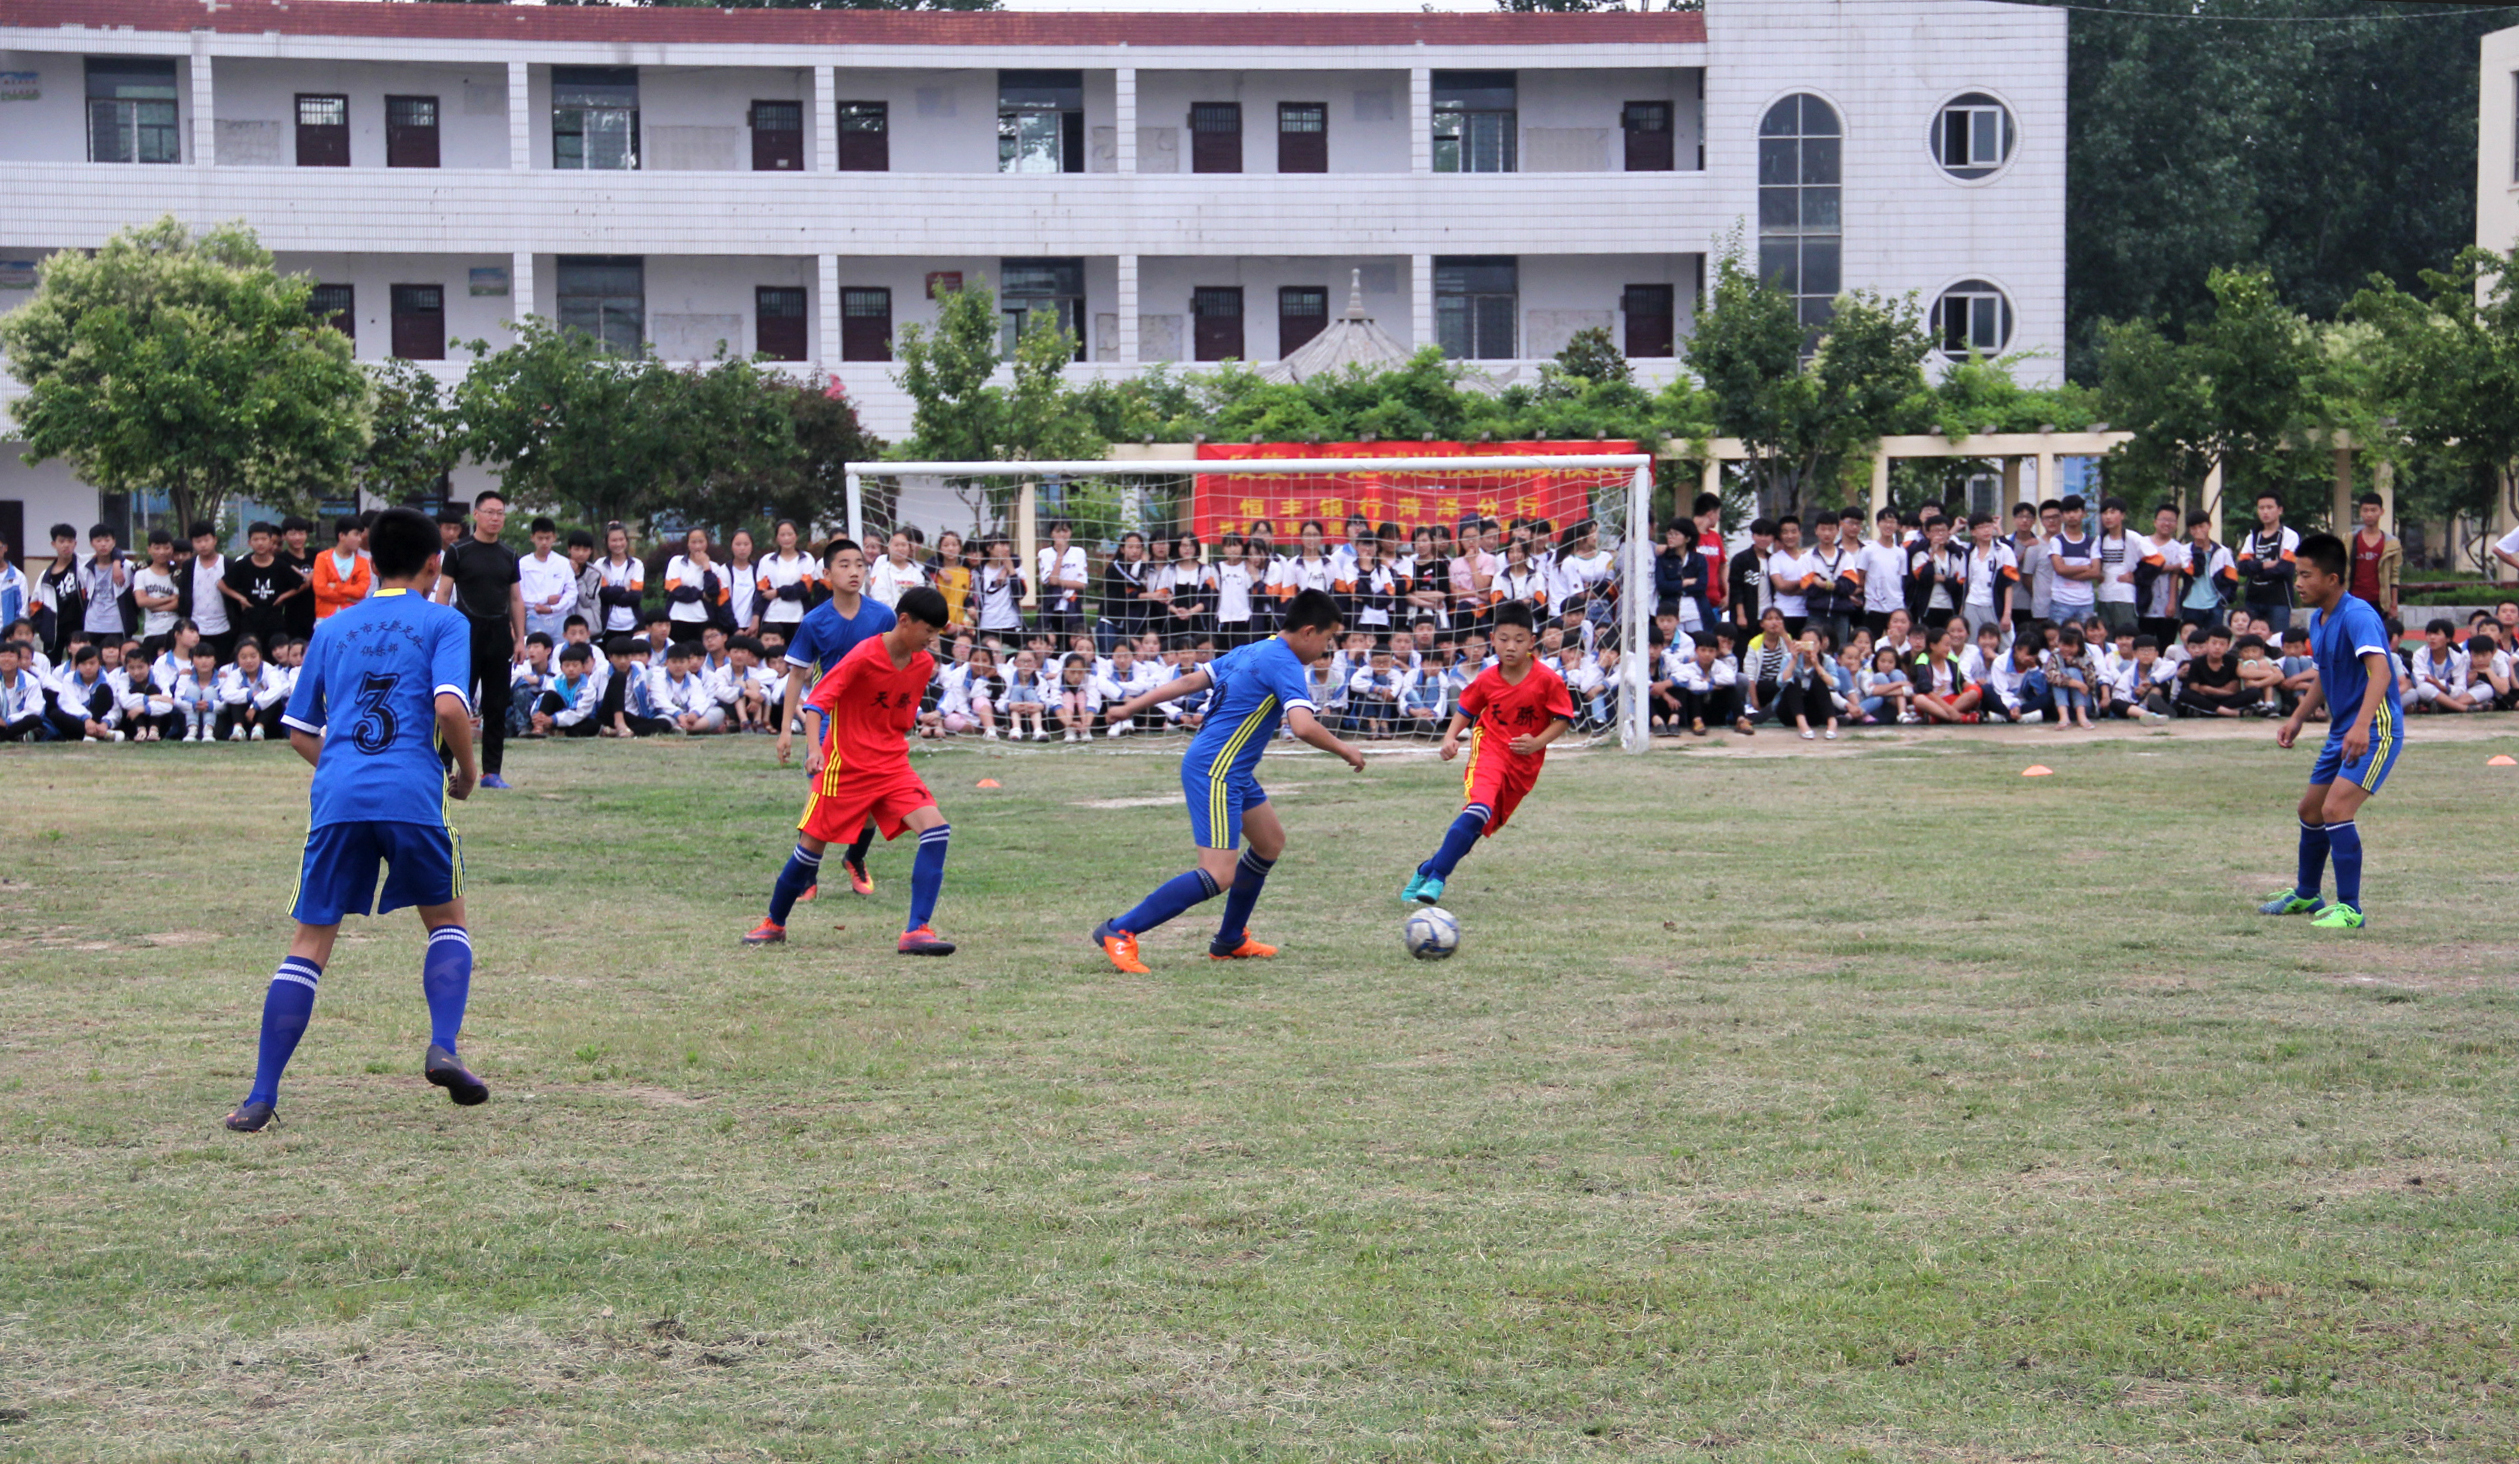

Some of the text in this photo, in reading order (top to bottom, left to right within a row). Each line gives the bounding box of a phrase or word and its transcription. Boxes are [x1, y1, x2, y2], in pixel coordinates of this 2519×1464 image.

[1239, 497, 1540, 518] 恒丰银行菏泽分行
[360, 642, 399, 657] 俱乐部
[352, 671, 400, 755] 3
[1491, 704, 1539, 728] 天骄
